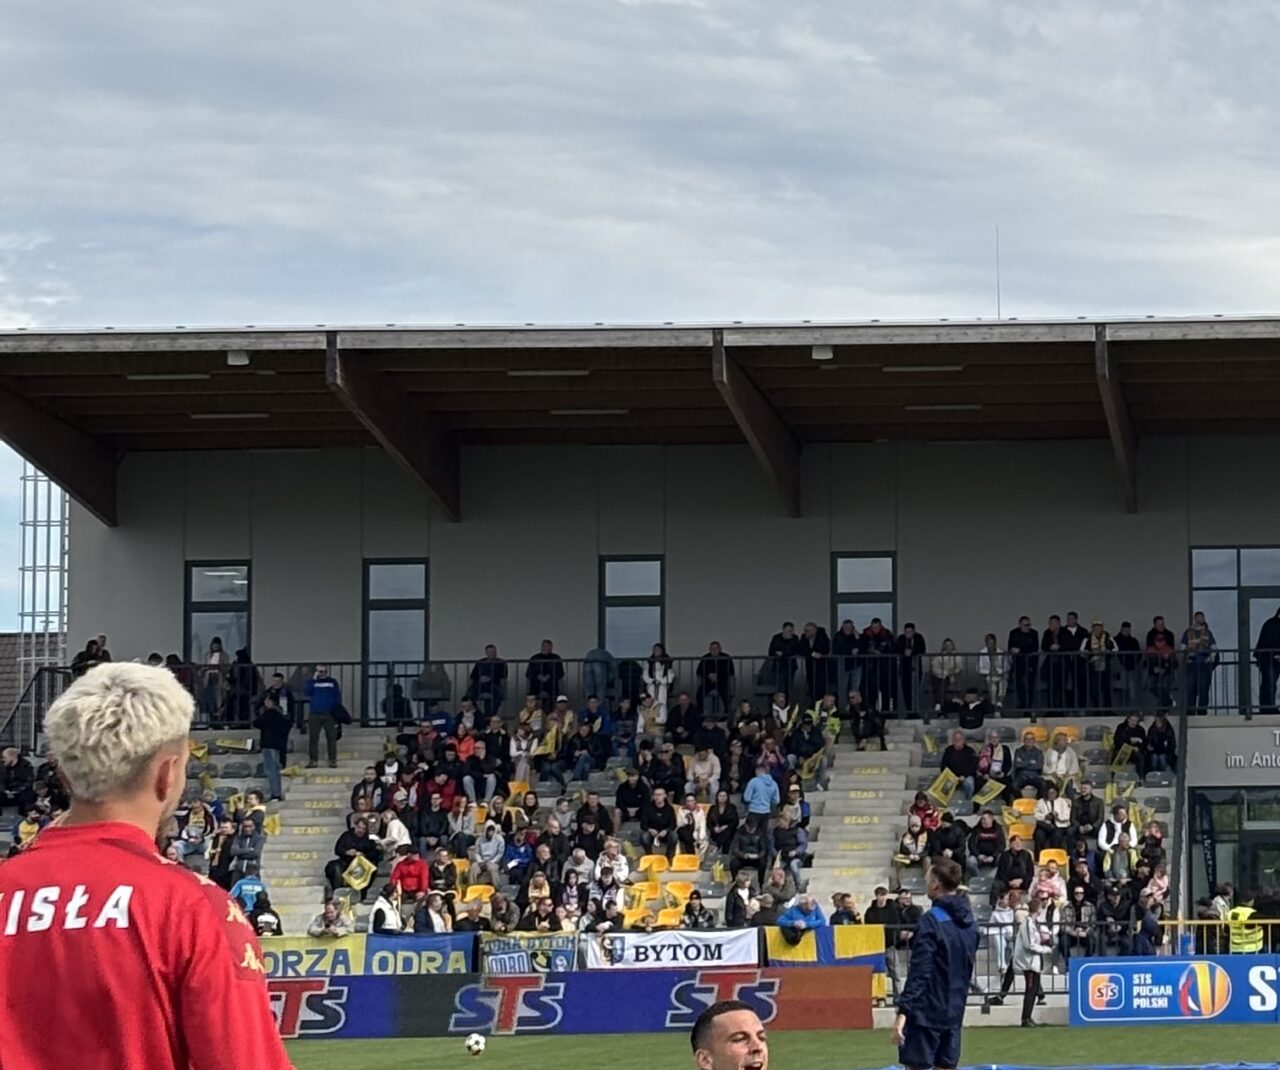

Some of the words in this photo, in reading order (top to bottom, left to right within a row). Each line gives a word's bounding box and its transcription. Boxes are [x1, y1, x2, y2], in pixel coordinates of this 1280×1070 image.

[1226, 752, 1248, 767] im.
[0, 884, 135, 936] ISŁA
[262, 948, 351, 976] ORZA
[371, 950, 467, 976] ODRA
[632, 943, 723, 963] BYTOM
[1132, 973, 1152, 985] STS
[266, 976, 349, 1039] TS
[447, 972, 565, 1035] STS
